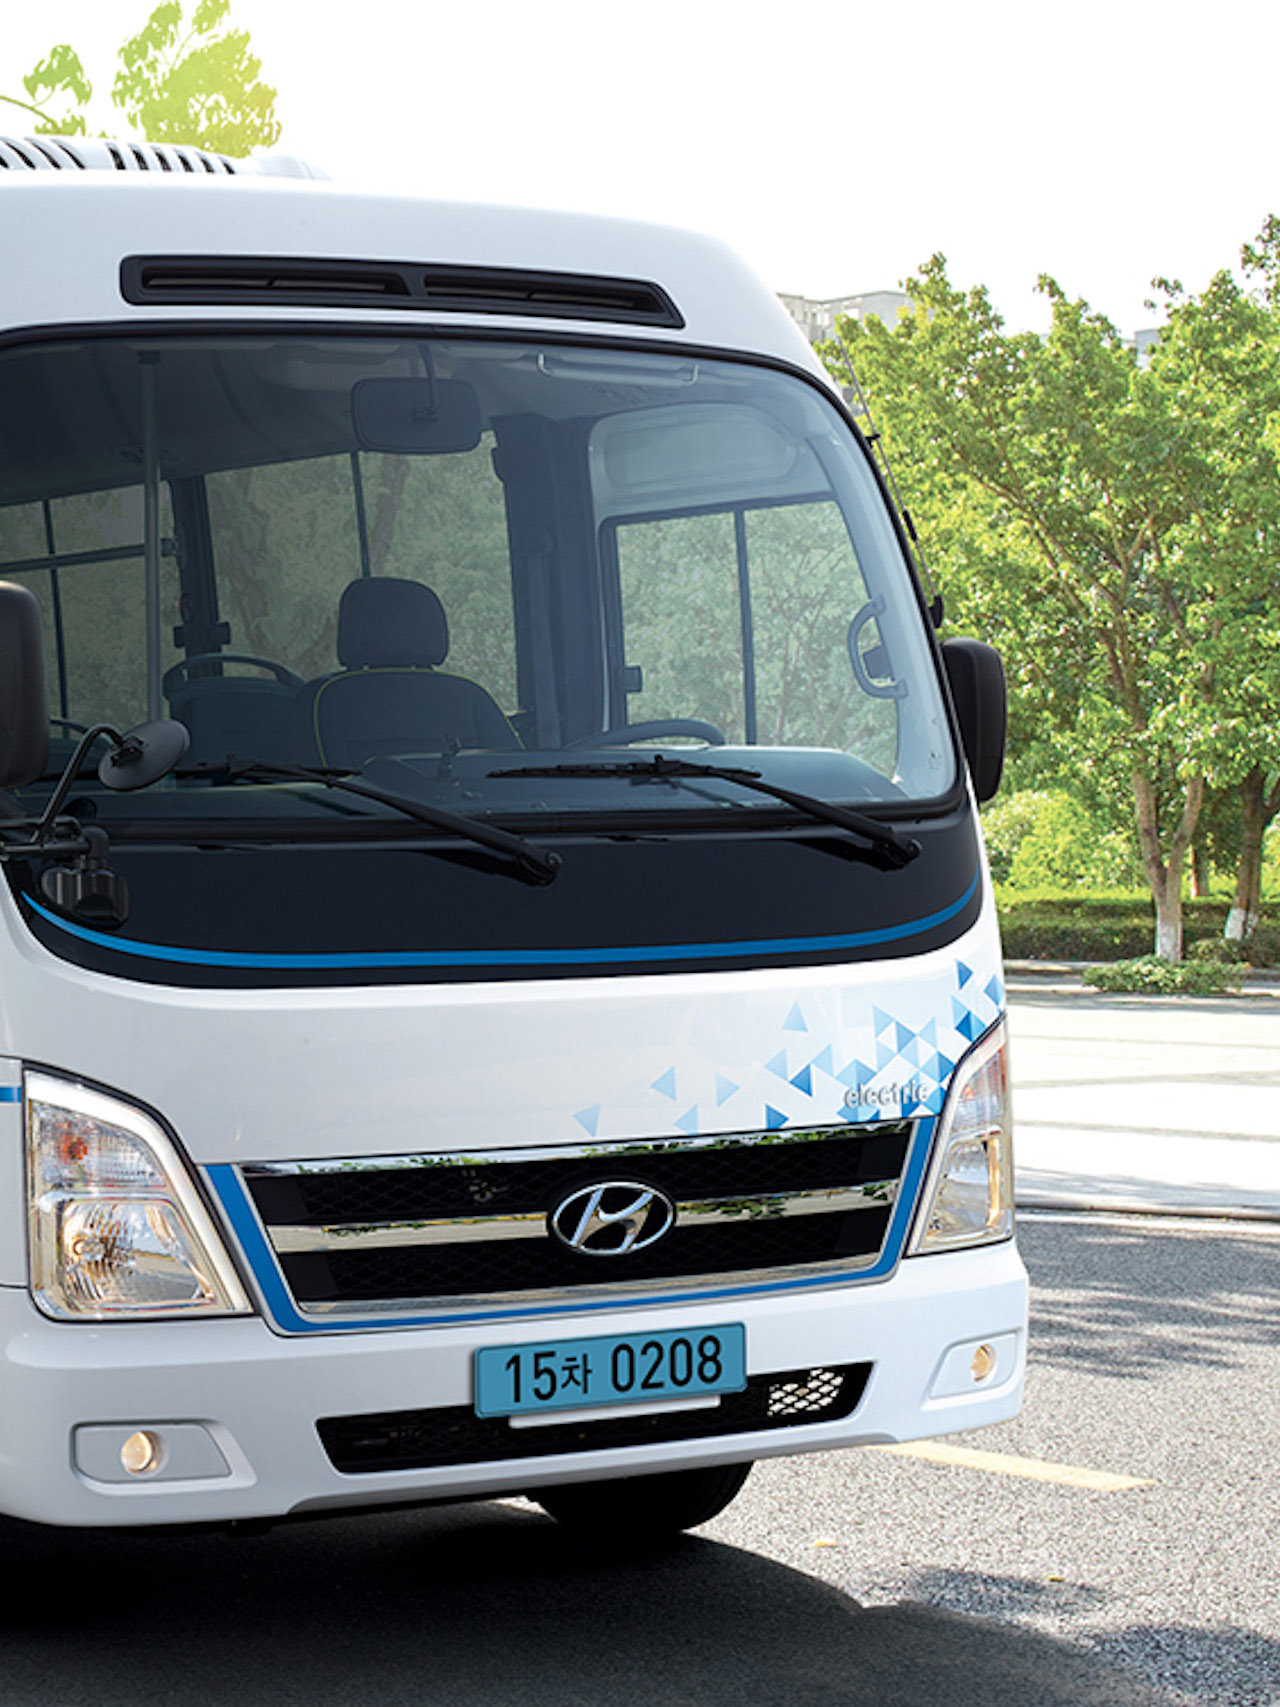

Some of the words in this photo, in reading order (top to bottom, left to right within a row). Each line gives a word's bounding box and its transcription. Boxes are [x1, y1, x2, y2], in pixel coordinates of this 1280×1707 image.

[844, 1080, 927, 1108] electric
[505, 1351, 593, 1402] 15차
[611, 1335, 722, 1392] 0208
